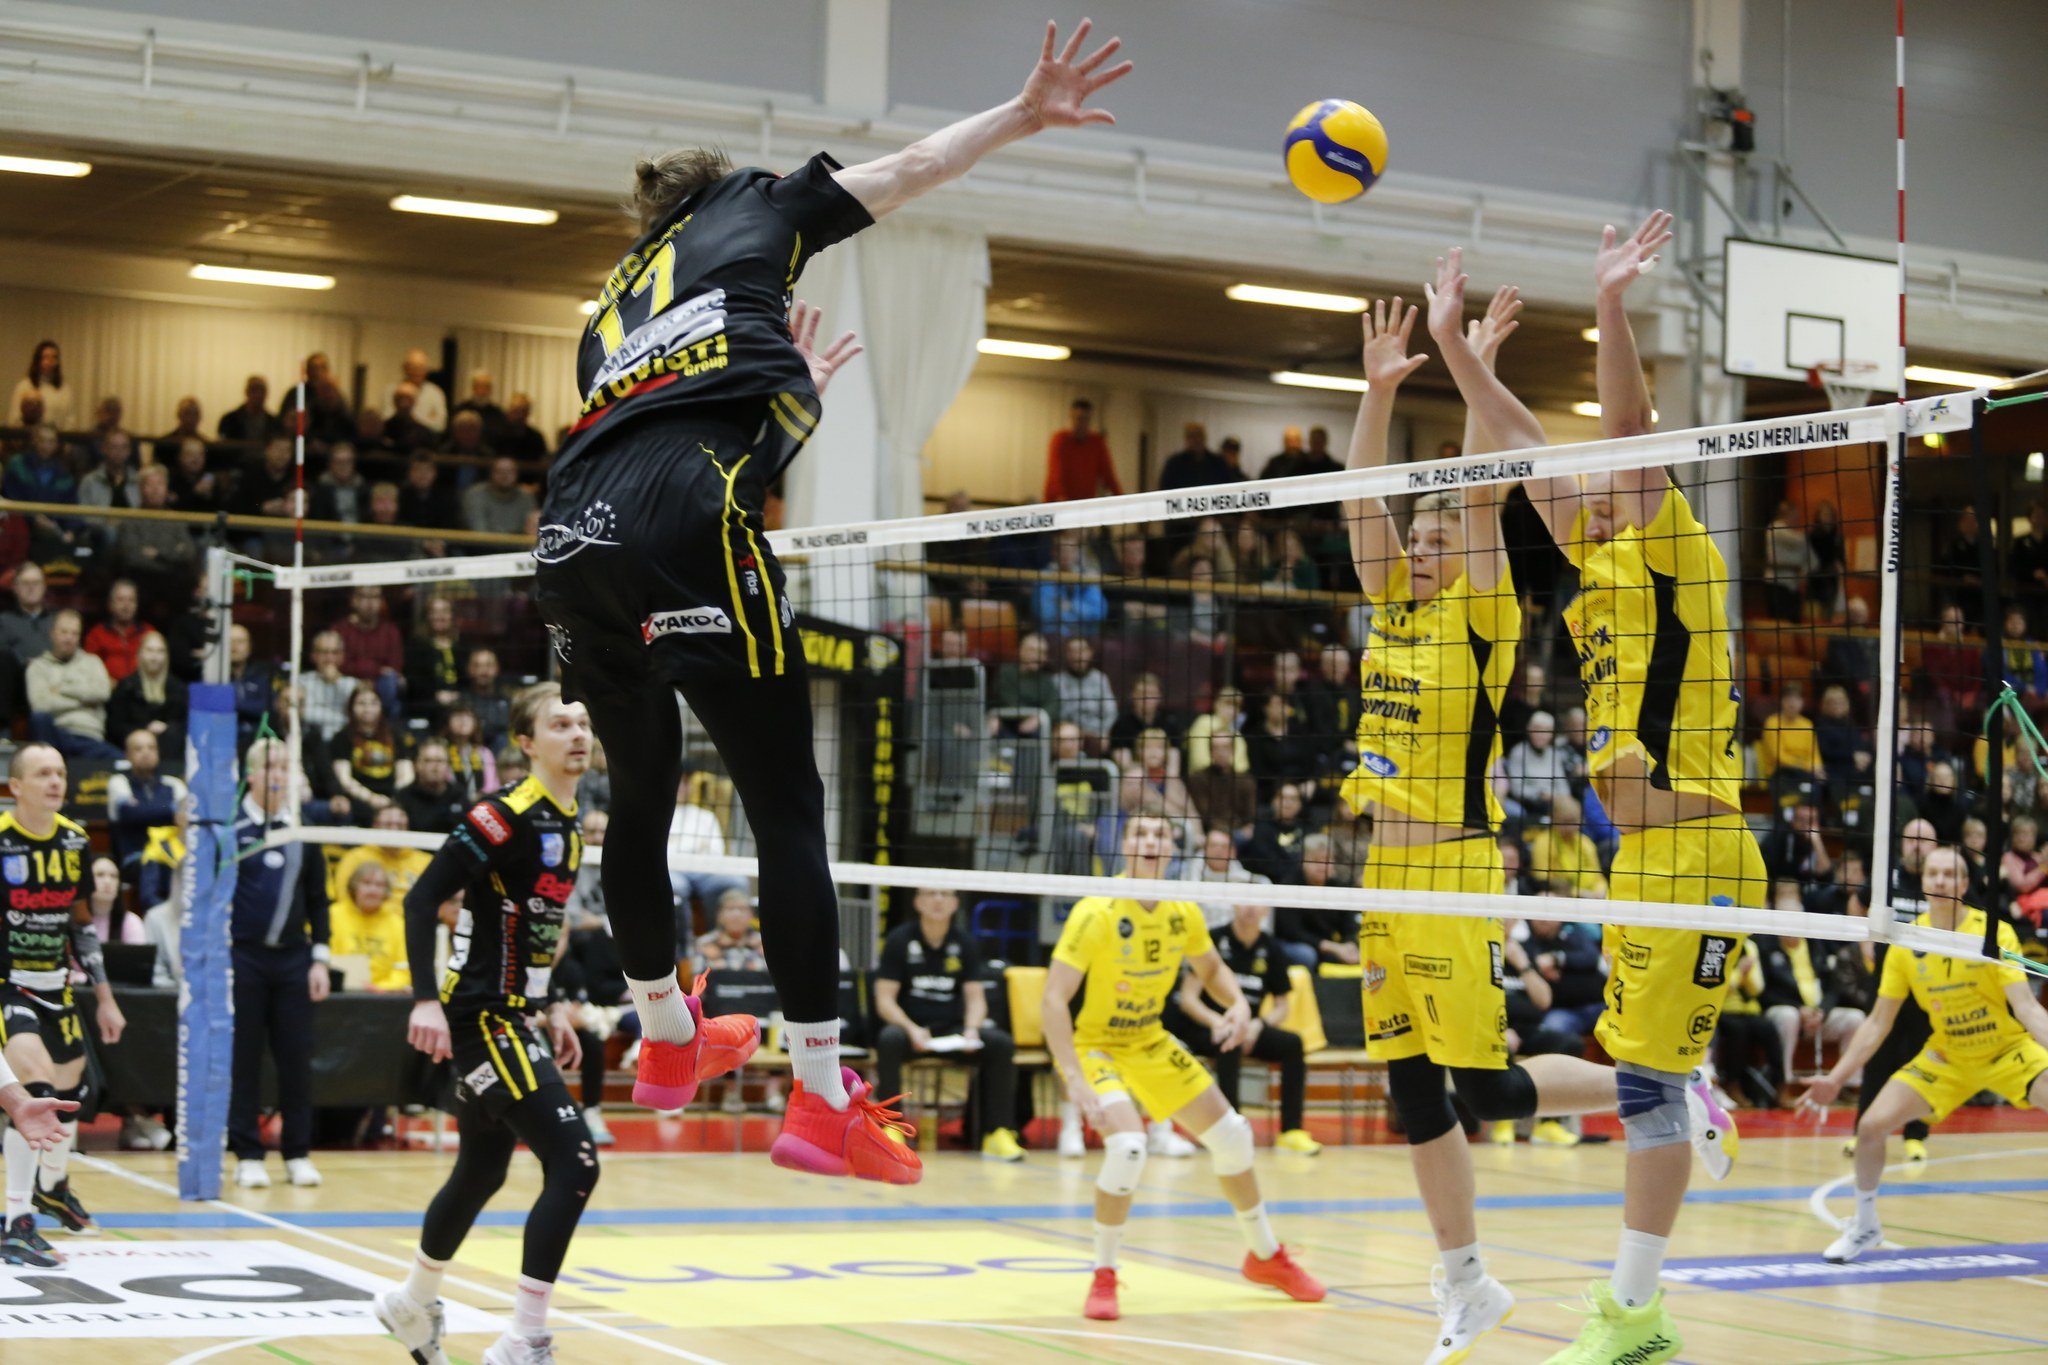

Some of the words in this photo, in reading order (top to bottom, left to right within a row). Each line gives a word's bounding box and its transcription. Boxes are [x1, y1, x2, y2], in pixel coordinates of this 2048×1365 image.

[592, 240, 677, 358] 17
[683, 353, 729, 377] Group
[1697, 436, 1725, 456] TMI.
[1728, 430, 1759, 452] PASI
[1763, 421, 1849, 448] MERILÄINEN
[1432, 467, 1459, 485] PASI
[1461, 459, 1535, 483] MERILÄINEN
[1186, 496, 1208, 512] PASI
[1210, 489, 1271, 510] MERILÄINEN
